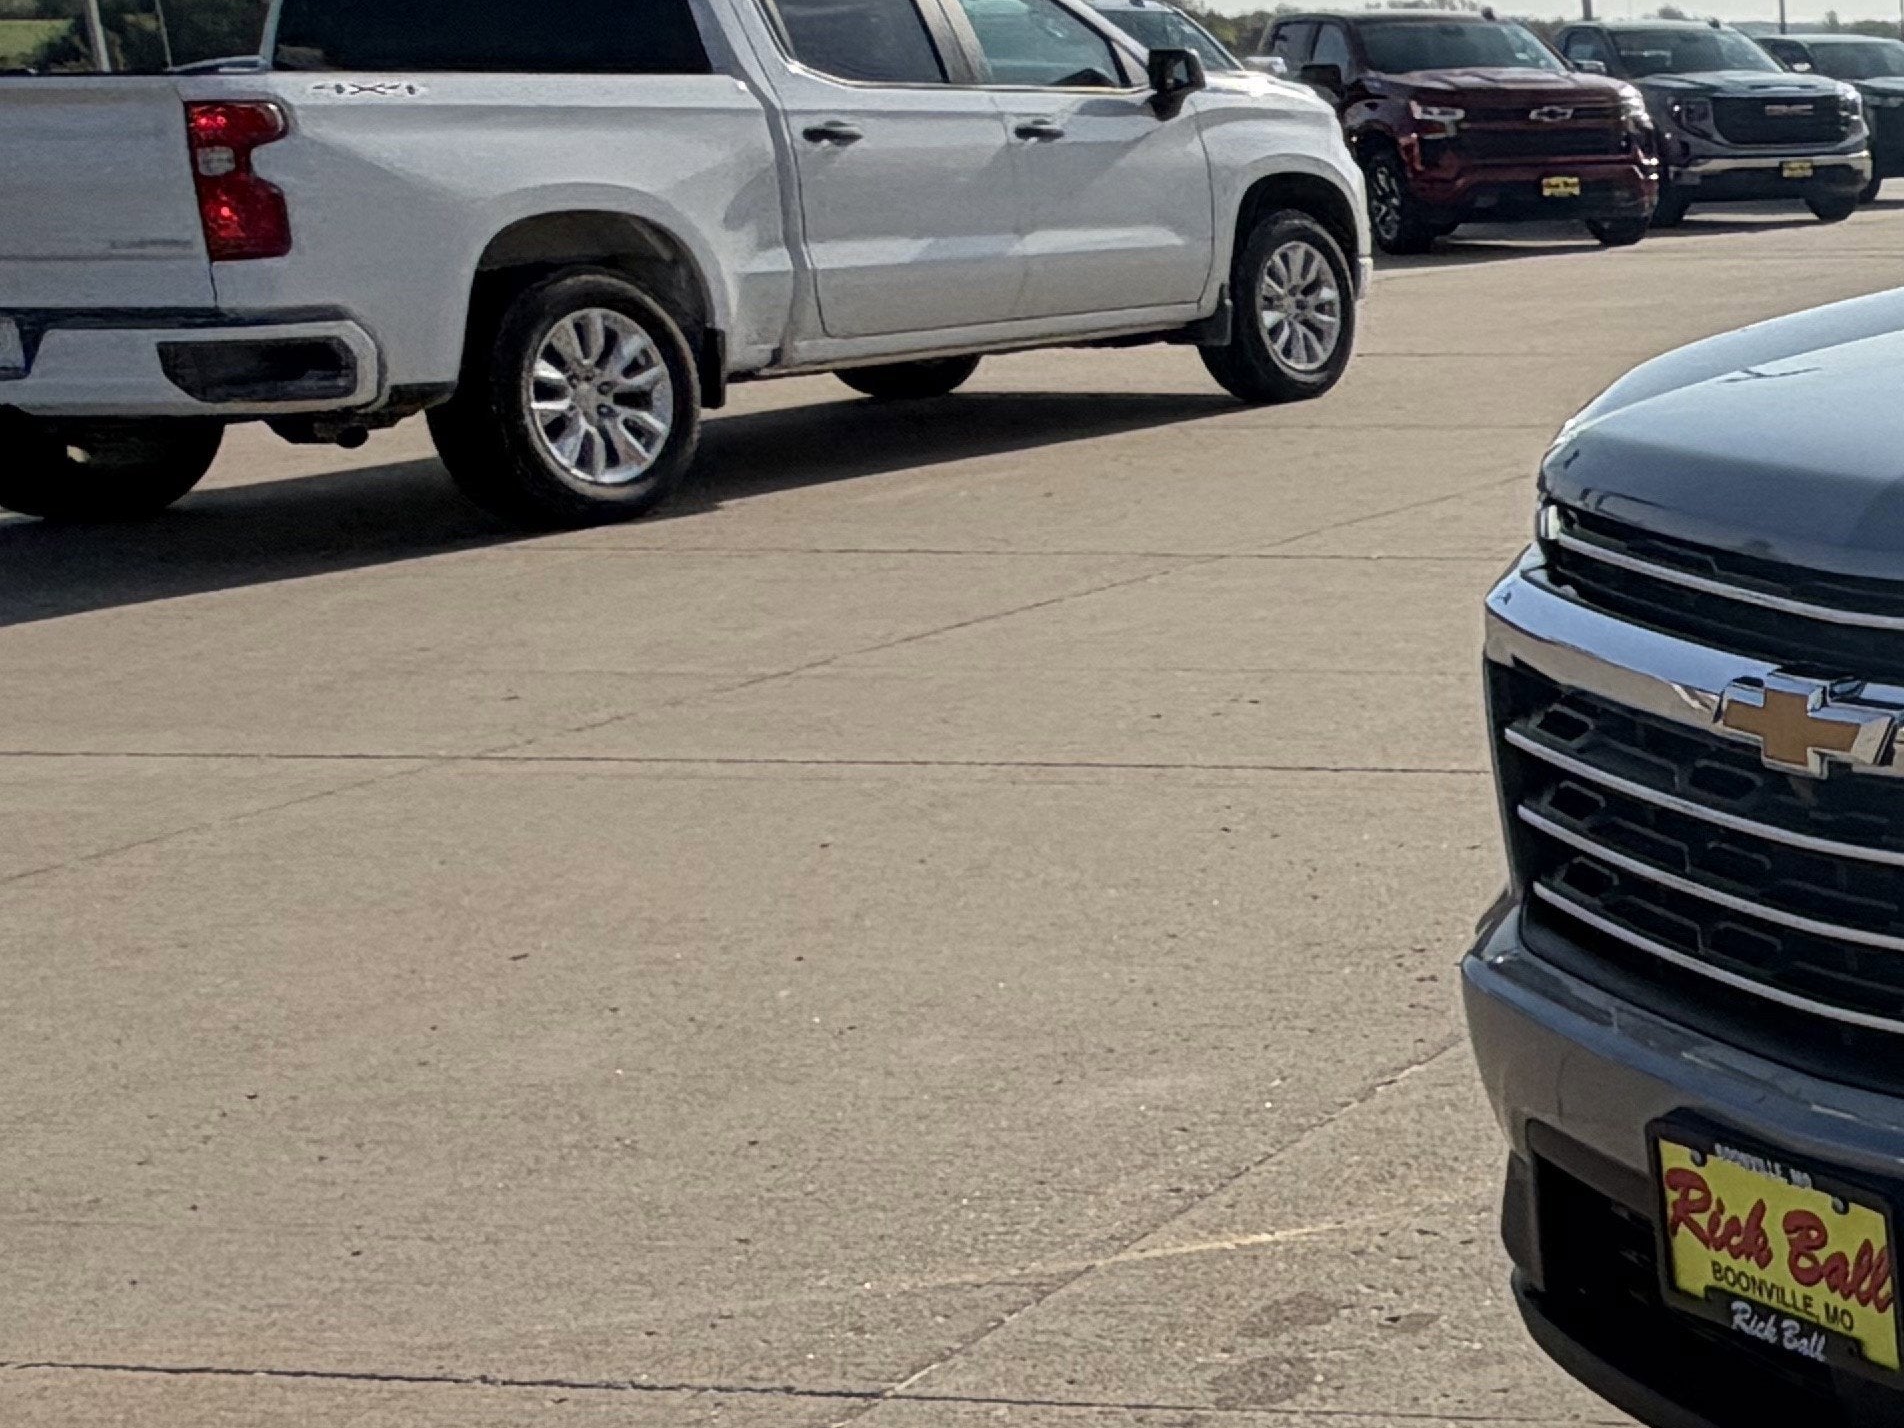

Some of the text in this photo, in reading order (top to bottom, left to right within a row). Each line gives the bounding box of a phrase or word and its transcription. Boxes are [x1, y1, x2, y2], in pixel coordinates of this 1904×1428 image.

[1664, 1167, 1894, 1313] Rick Ball
[1731, 1300, 1827, 1362] Rick Ball
[1824, 1301, 1855, 1332] MO
